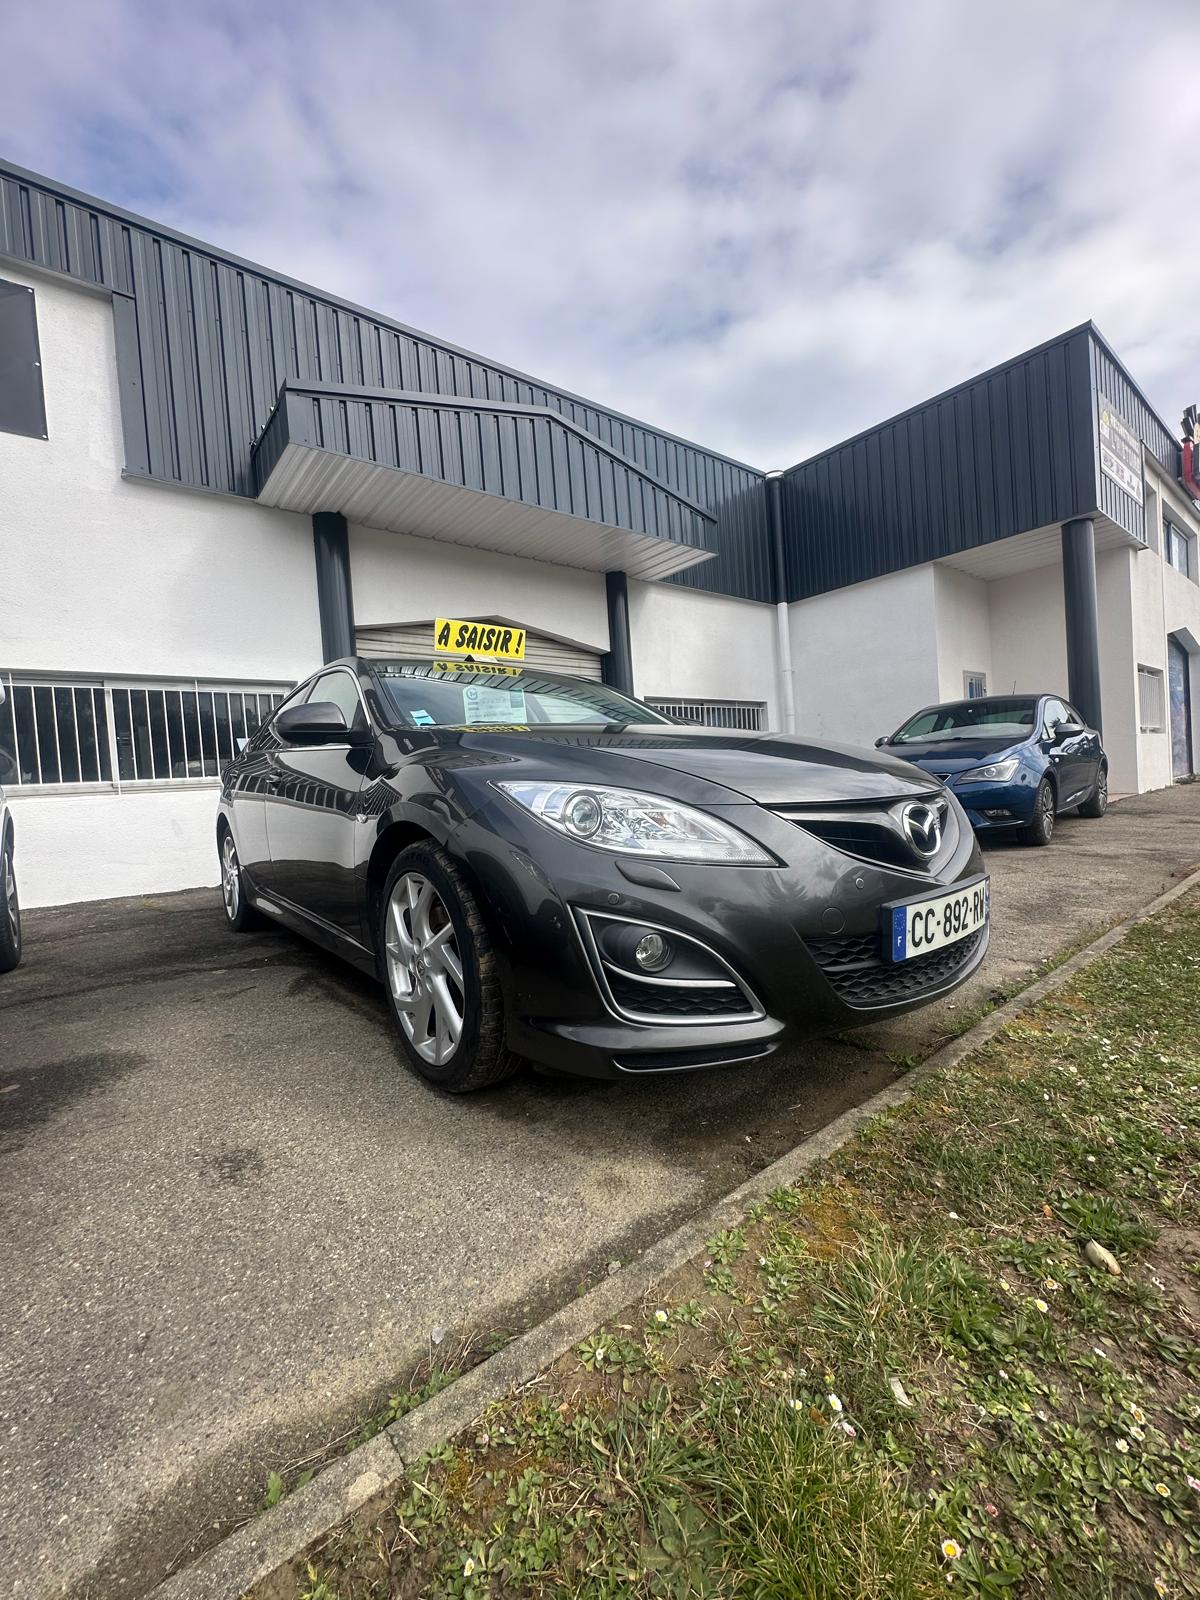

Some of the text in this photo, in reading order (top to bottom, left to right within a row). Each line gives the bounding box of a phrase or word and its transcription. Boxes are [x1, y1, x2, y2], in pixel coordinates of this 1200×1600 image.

[437, 622, 451, 647] A
[455, 624, 512, 653] SAISIR
[897, 887, 984, 948] F CC-892-RW
